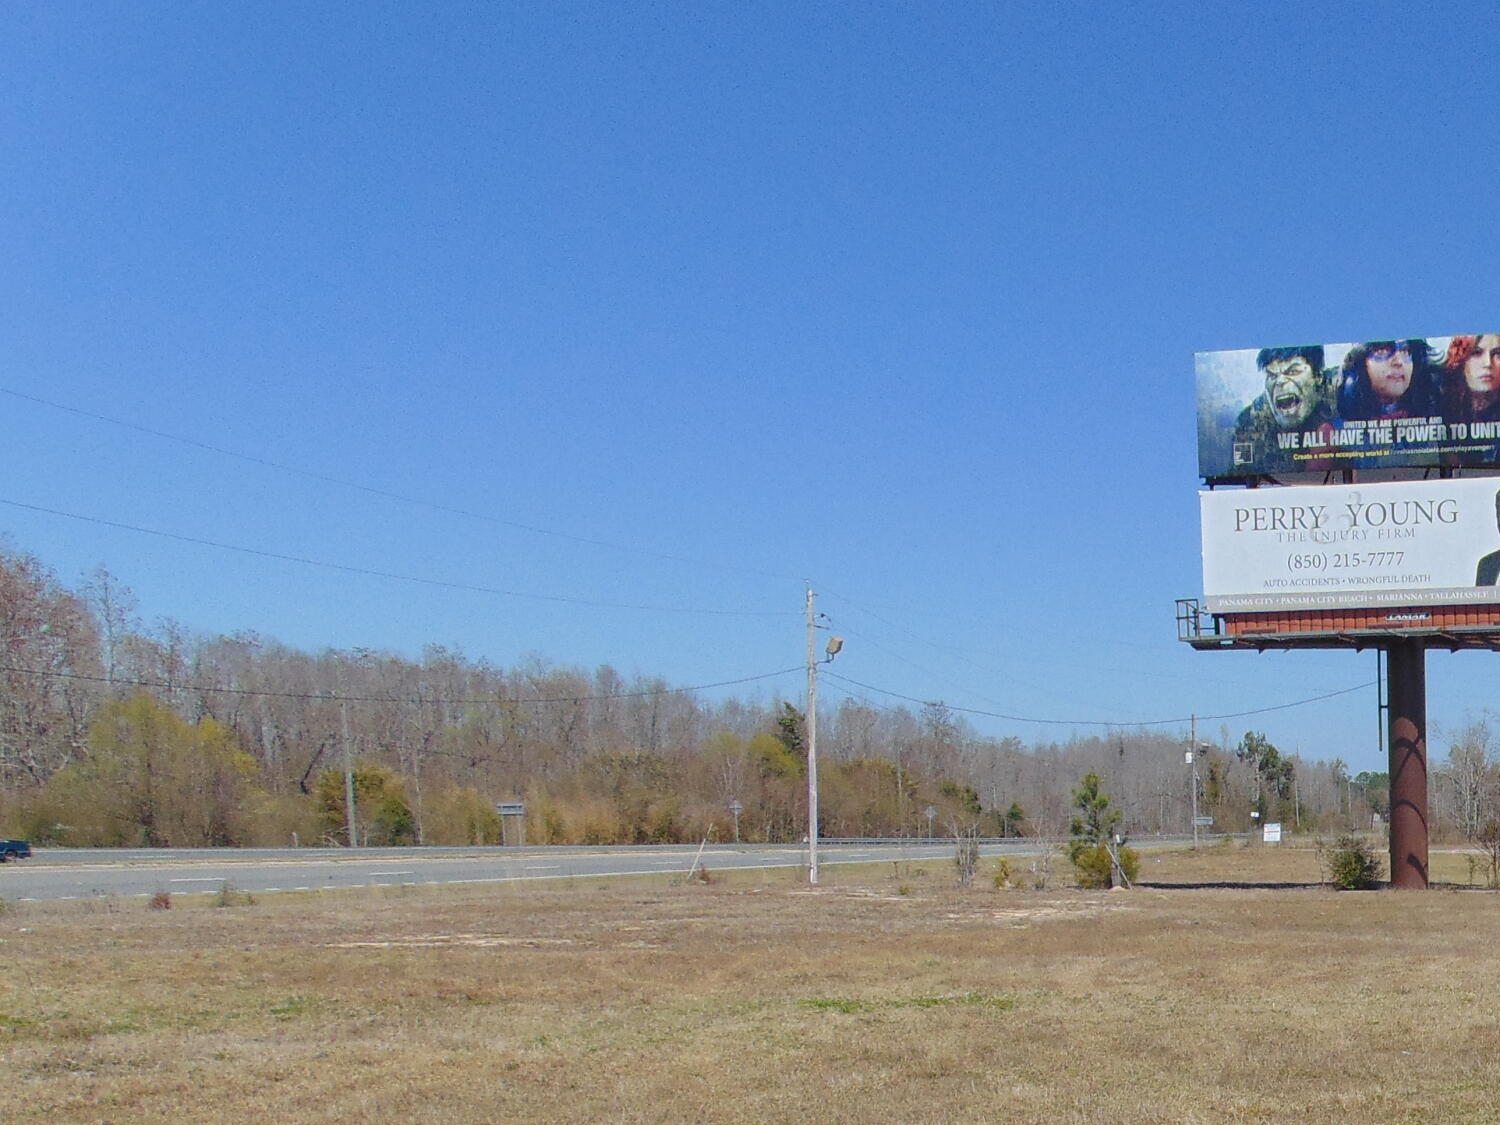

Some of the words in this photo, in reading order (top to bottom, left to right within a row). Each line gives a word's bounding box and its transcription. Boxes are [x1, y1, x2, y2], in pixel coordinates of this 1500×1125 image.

[1343, 420, 1367, 429] UNITED
[1368, 420, 1378, 428] WE
[1380, 419, 1392, 428] ARE
[1394, 417, 1427, 427] POWERFUL
[1429, 416, 1443, 424] AND
[1277, 432, 1300, 449] WE
[1302, 431, 1327, 448] ALL
[1329, 428, 1365, 446] HAVE
[1367, 427, 1393, 445] THE
[1396, 424, 1447, 443] POWER
[1449, 423, 1468, 440] TO
[1335, 451, 1365, 459] accepting
[1365, 449, 1382, 457] world
[1234, 505, 1326, 532] PERRY
[1345, 499, 1459, 528] YOUNG
[1278, 532, 1307, 543] THE
[1313, 529, 1369, 543] INJURY
[1378, 527, 1416, 539] FIRM
[1287, 552, 1328, 573] (850)
[1333, 551, 1405, 568] 215-7777
[1263, 579, 1288, 588] AUTO
[1289, 577, 1341, 587] ACCIDENTS
[1347, 575, 1400, 585] WRONGFUL
[1401, 574, 1431, 583] DEATH
[1219, 599, 1253, 607] PANAMA
[1281, 597, 1315, 605] PANAMA
[1376, 592, 1423, 601] MARIANNA
